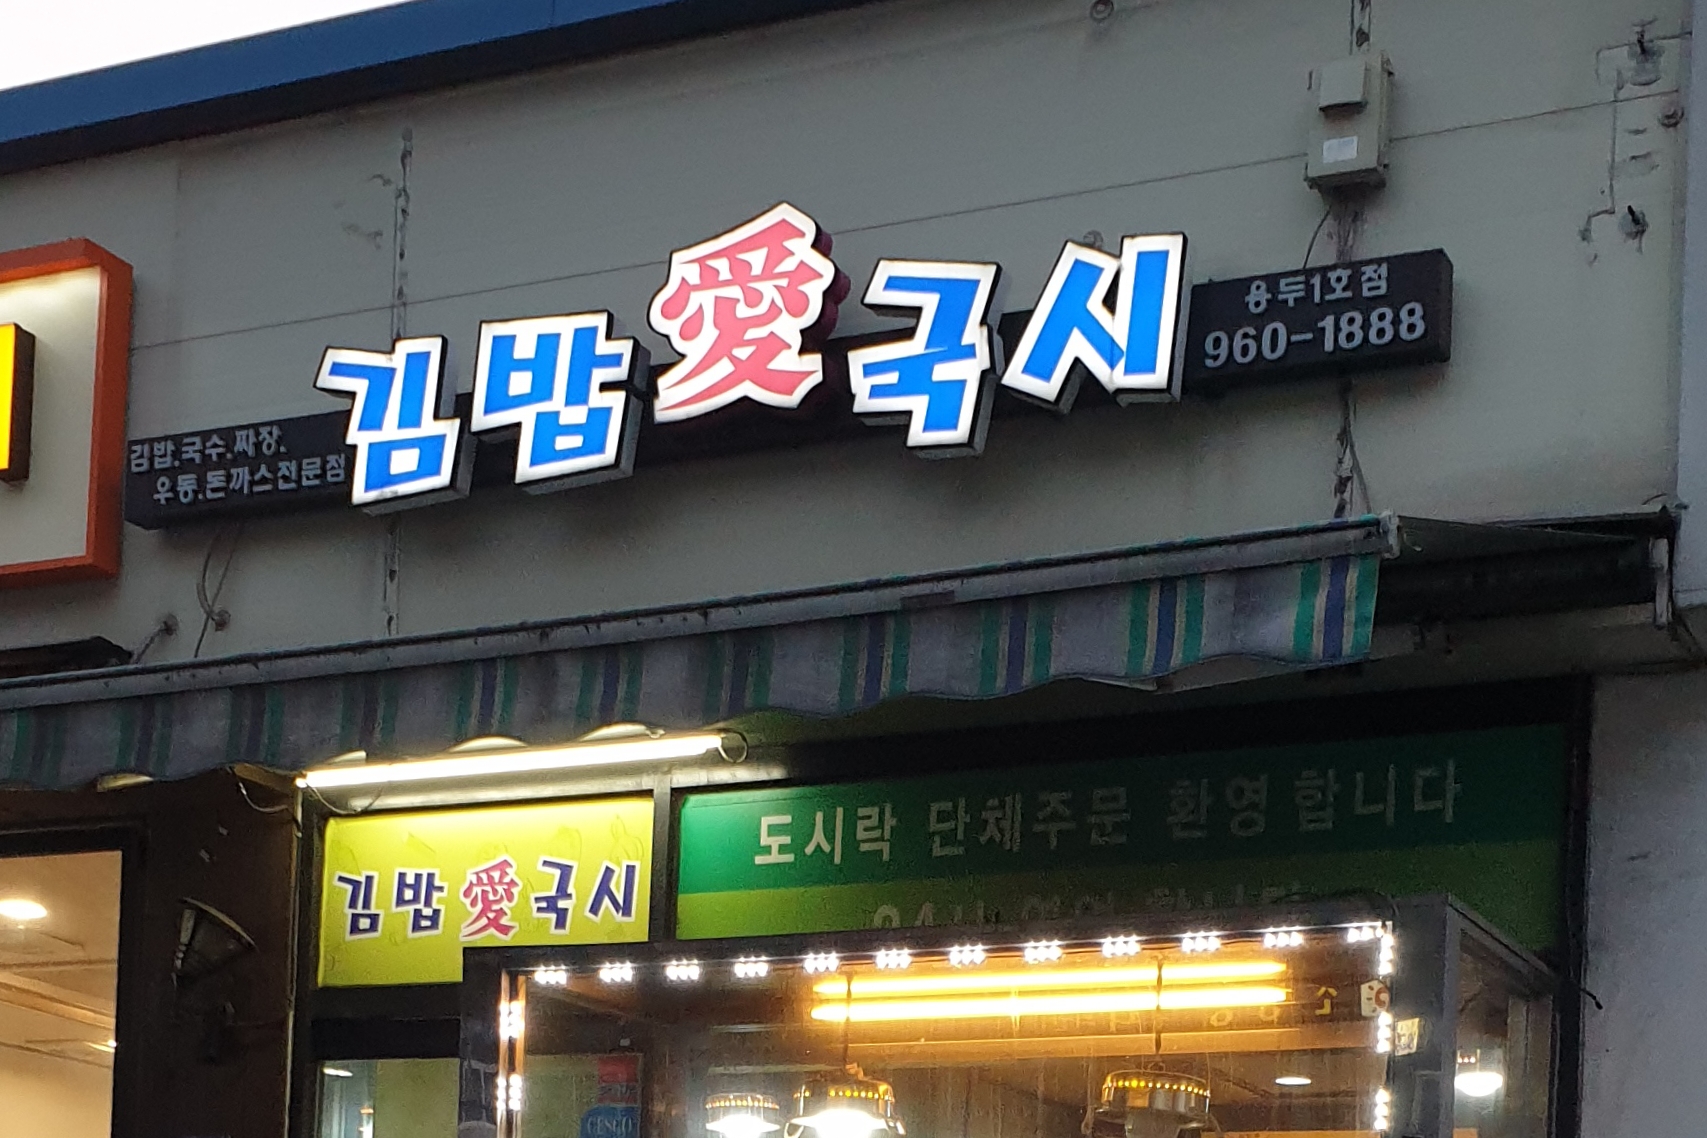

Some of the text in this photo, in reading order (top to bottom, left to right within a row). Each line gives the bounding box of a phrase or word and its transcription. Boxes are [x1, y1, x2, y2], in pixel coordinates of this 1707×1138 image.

[1244, 261, 1389, 314] 용두1호점
[1204, 301, 1426, 368] 960-1888
[753, 803, 900, 866] 도시락
[927, 784, 1132, 858] 단체주문
[334, 855, 641, 941] 김밥愛국시
